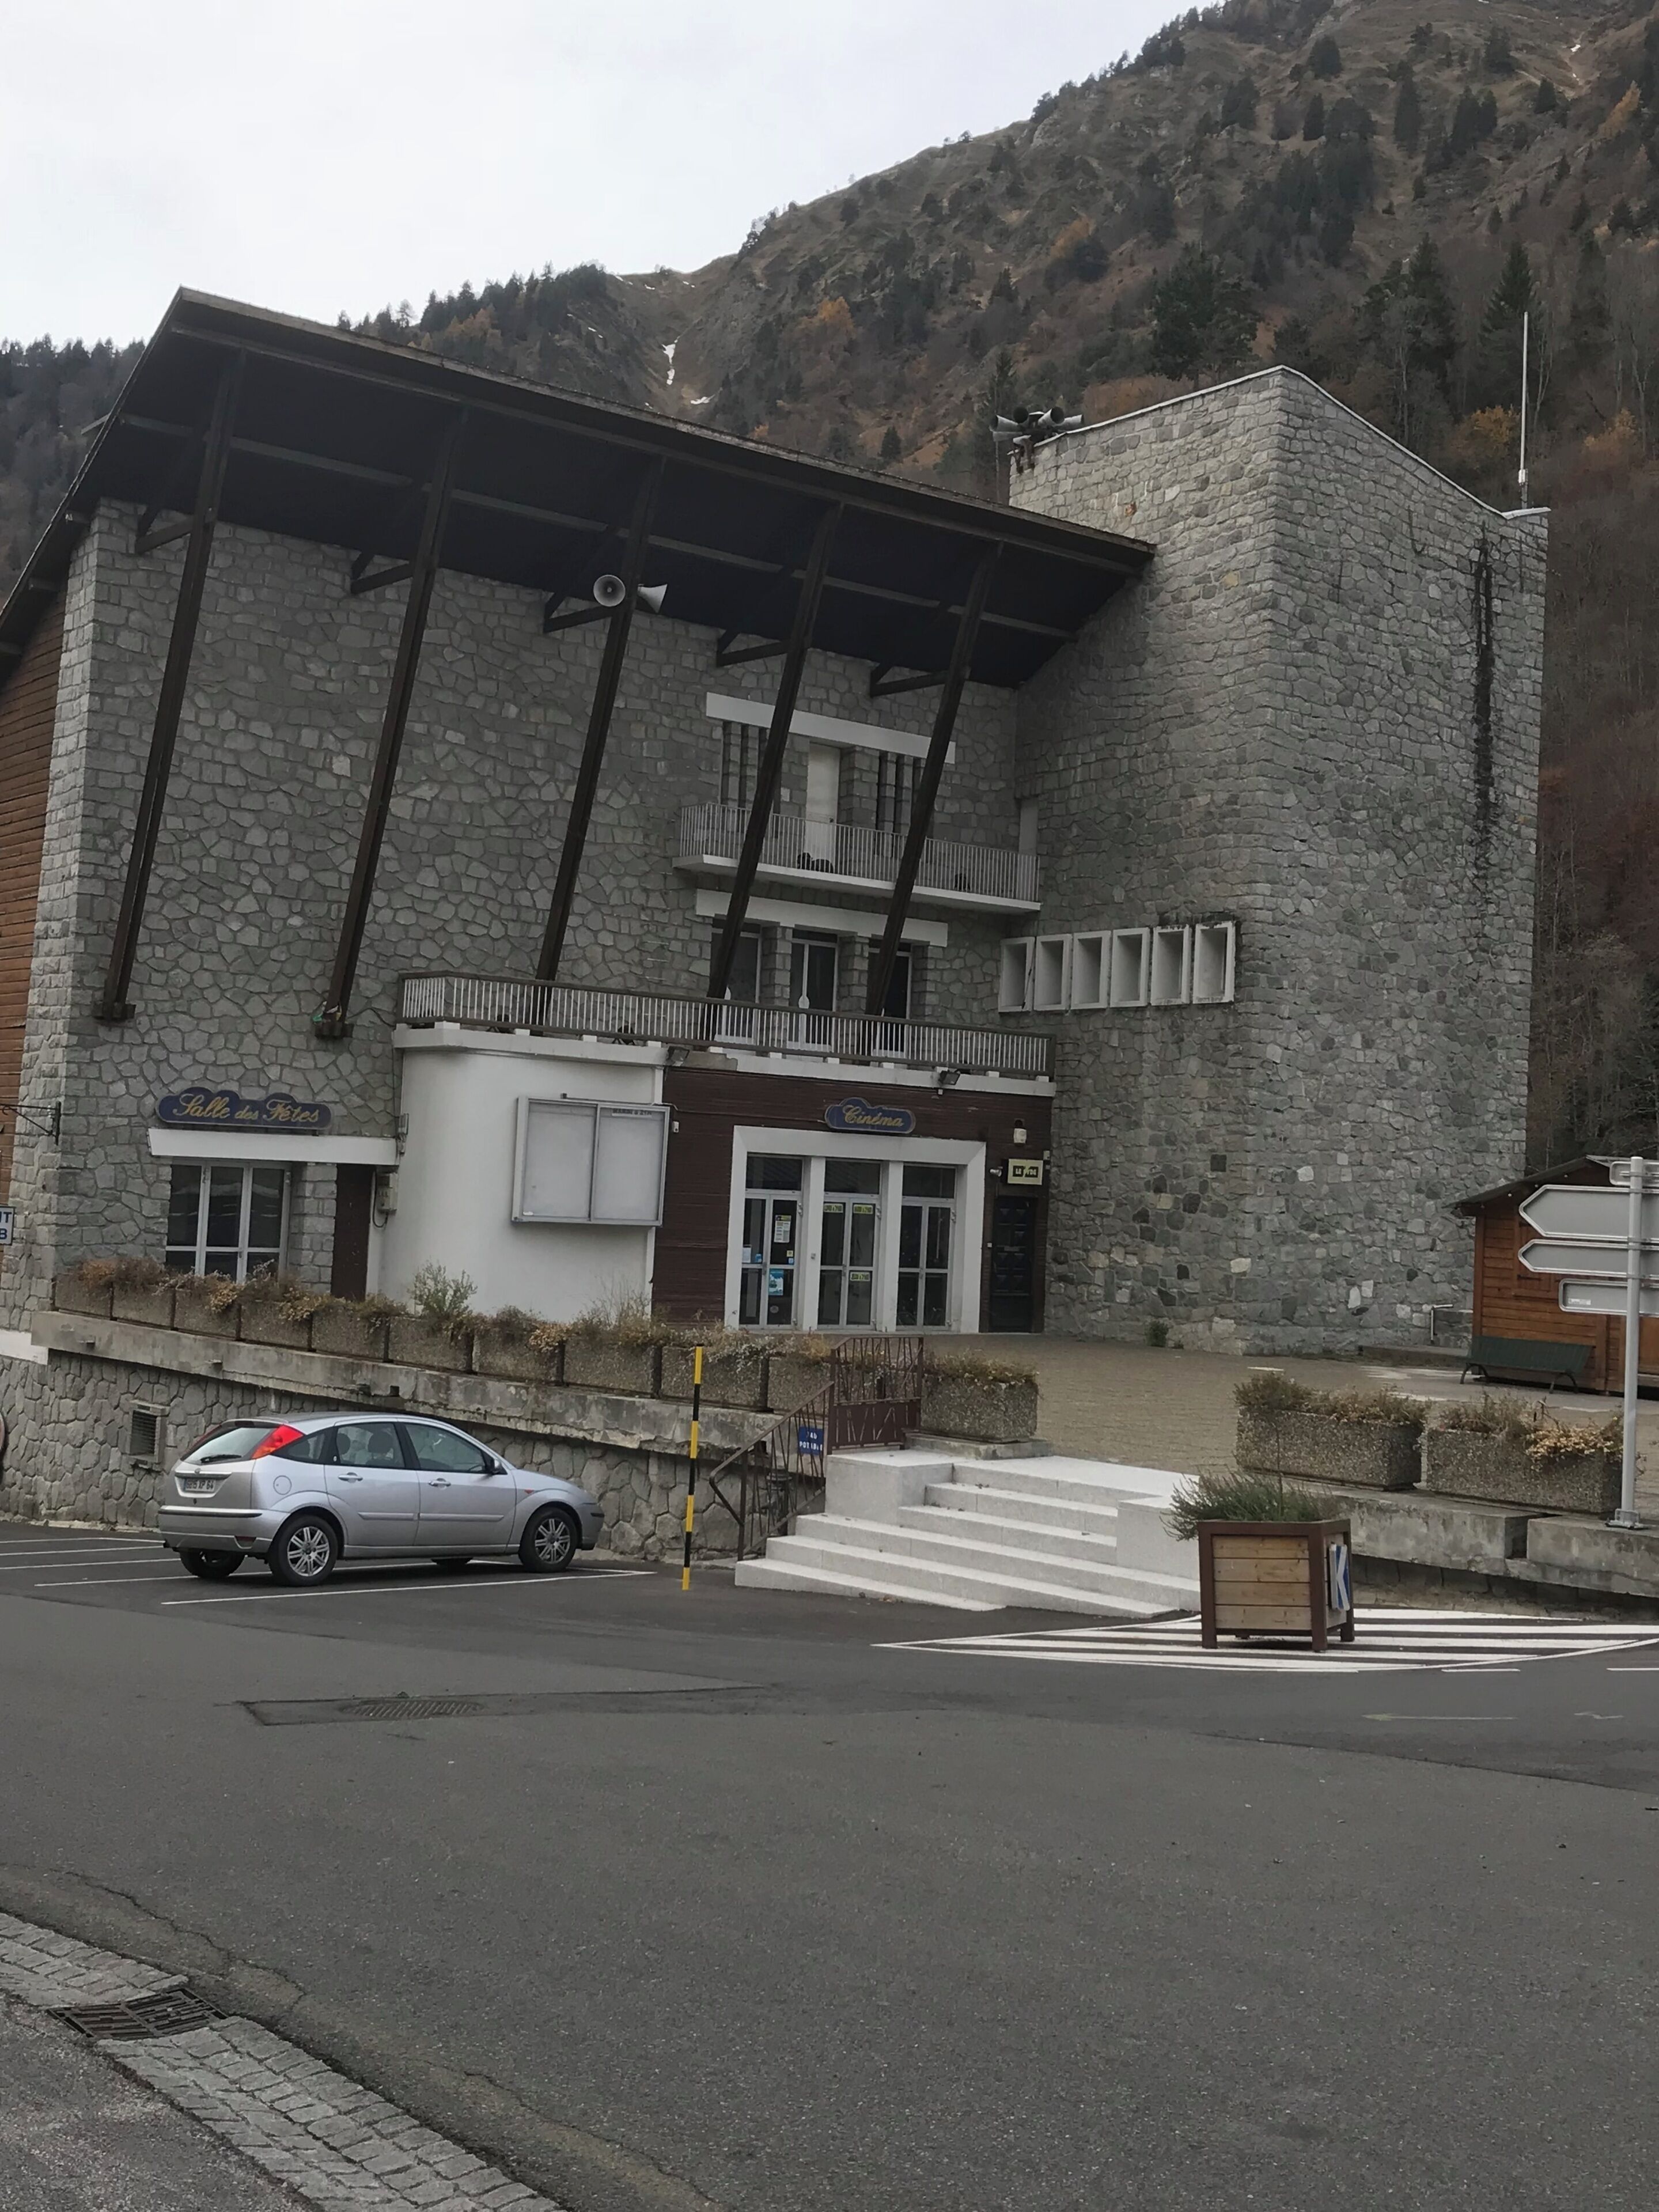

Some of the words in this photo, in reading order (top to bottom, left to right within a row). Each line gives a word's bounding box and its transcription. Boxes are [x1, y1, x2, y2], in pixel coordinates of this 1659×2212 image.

[172, 1093, 230, 1118] Salle
[234, 1105, 259, 1120] des
[262, 1099, 319, 1122] Fêtes
[843, 1105, 904, 1127] Cinéma
